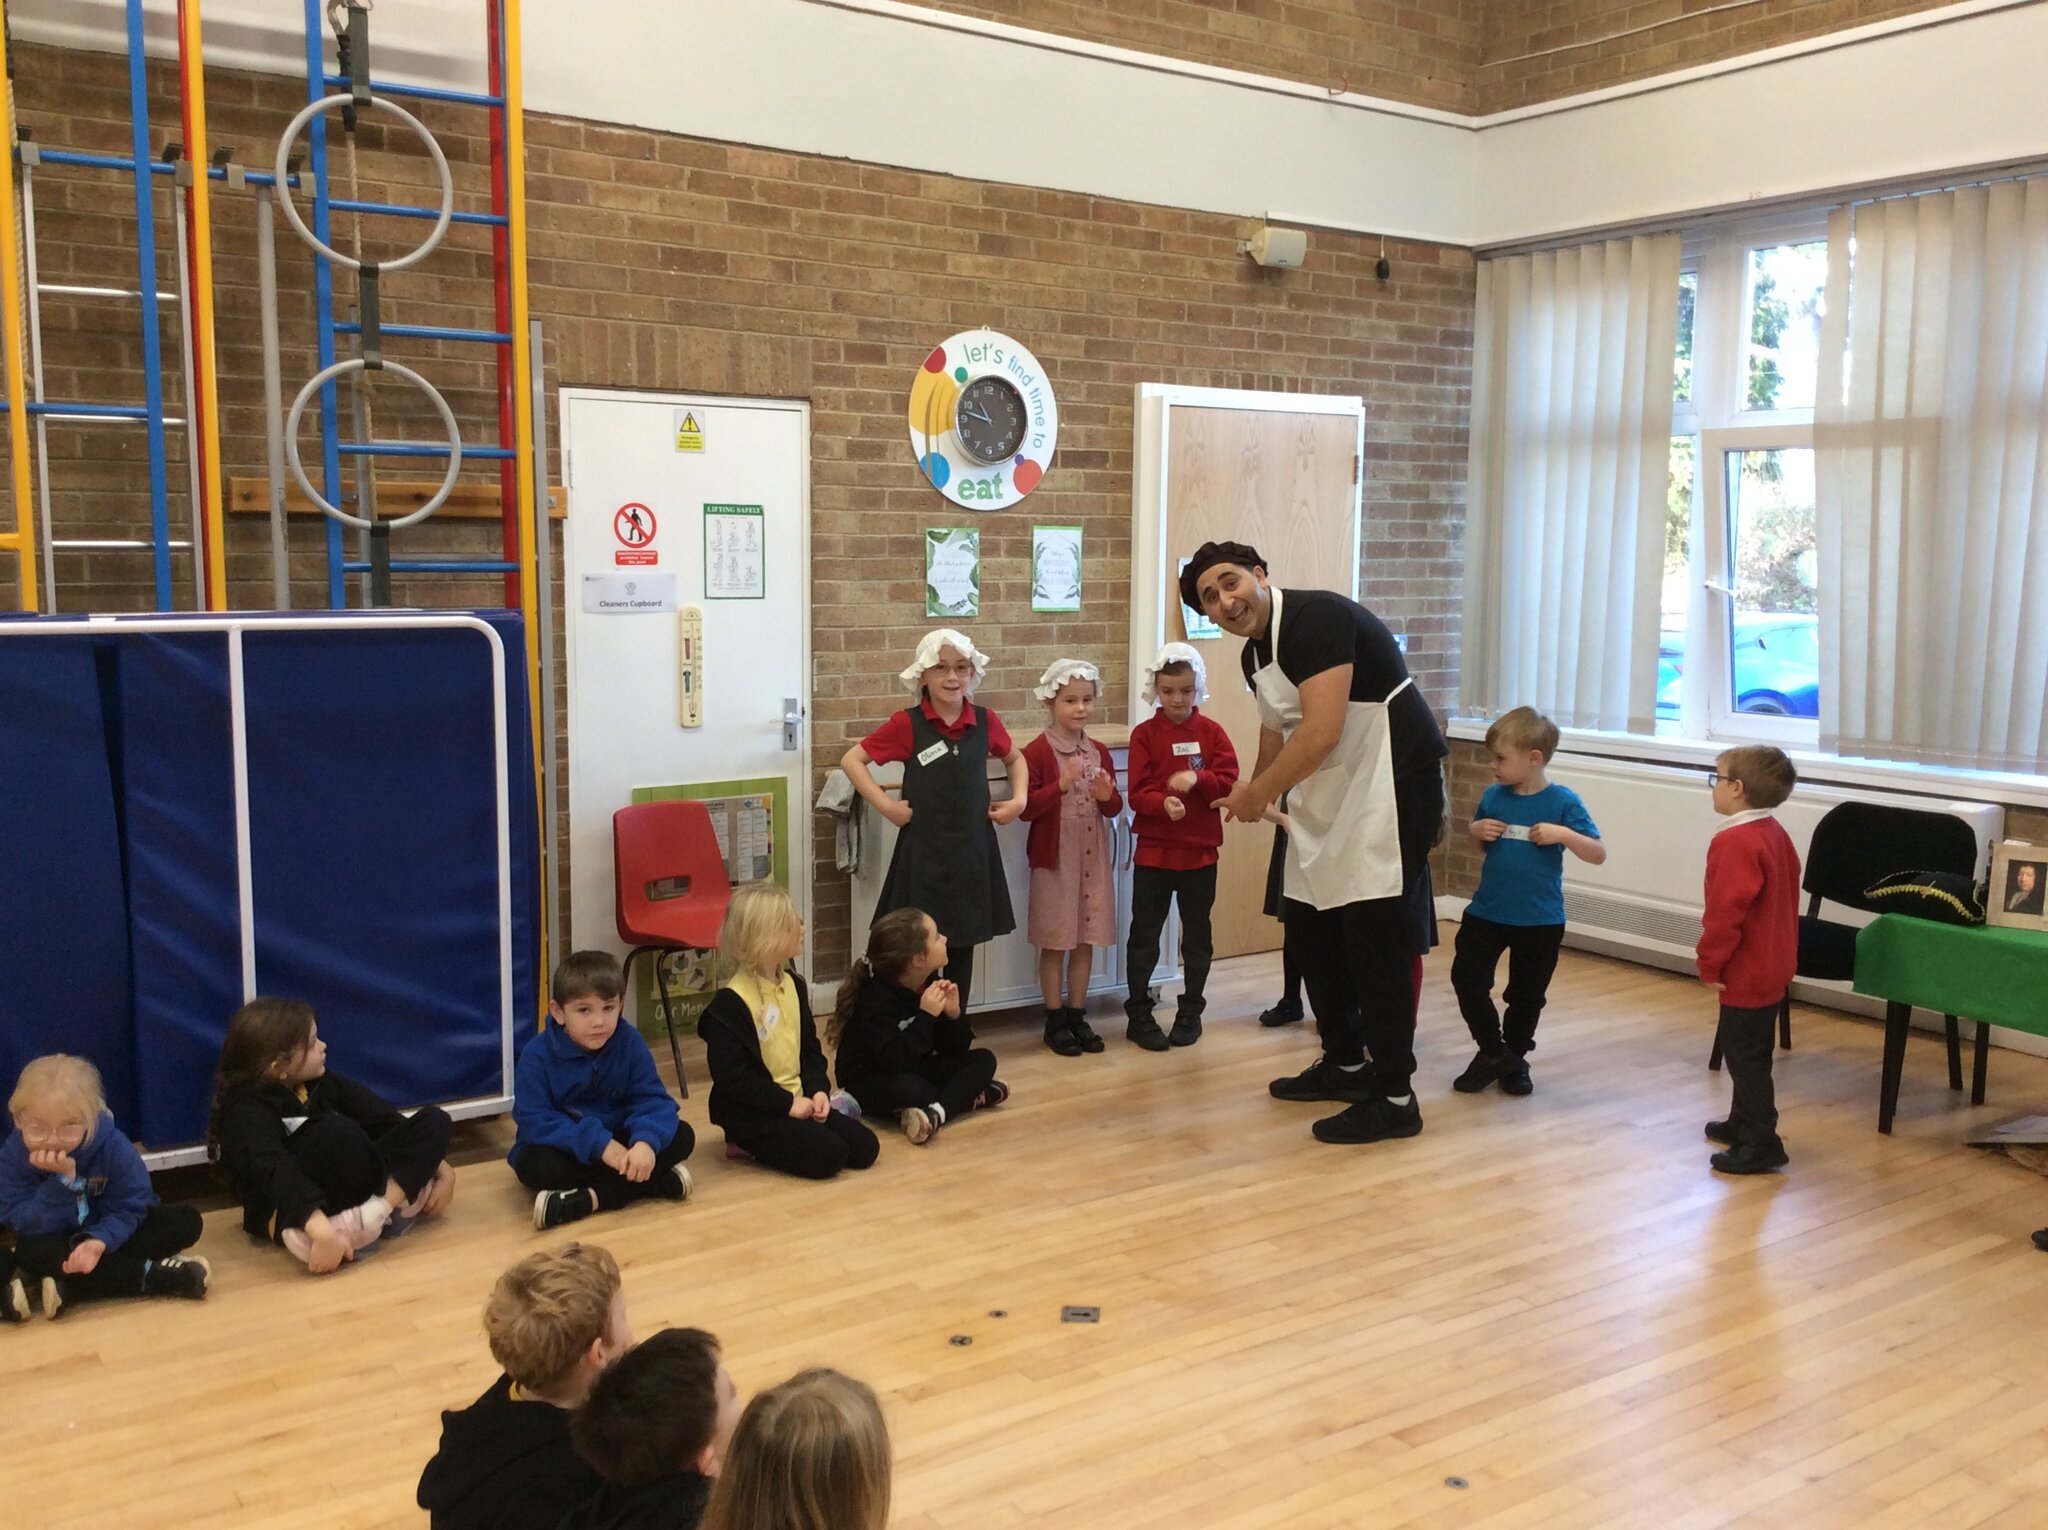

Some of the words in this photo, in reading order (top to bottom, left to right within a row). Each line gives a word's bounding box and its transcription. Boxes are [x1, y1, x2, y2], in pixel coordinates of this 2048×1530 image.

[963, 343, 1004, 365] let's
[1007, 355, 1035, 387] find
[973, 390, 979, 399] 11
[984, 386, 994, 395] 12
[1000, 391, 1004, 400] 1
[964, 401, 973, 410] 10
[1006, 403, 1014, 412] 2
[1029, 387, 1046, 427] time
[961, 415, 968, 423] 9
[1010, 417, 1017, 425] 3
[964, 429, 971, 438] 8
[1006, 430, 1013, 439] 4
[974, 441, 981, 449] 7
[998, 441, 1005, 450] 5
[1033, 433, 1047, 449] to
[985, 446, 992, 455] 6
[957, 472, 1004, 500] eat
[707, 505, 735, 513] LIFTING
[736, 506, 760, 514] SAFELY
[630, 600, 662, 608] Cupboard
